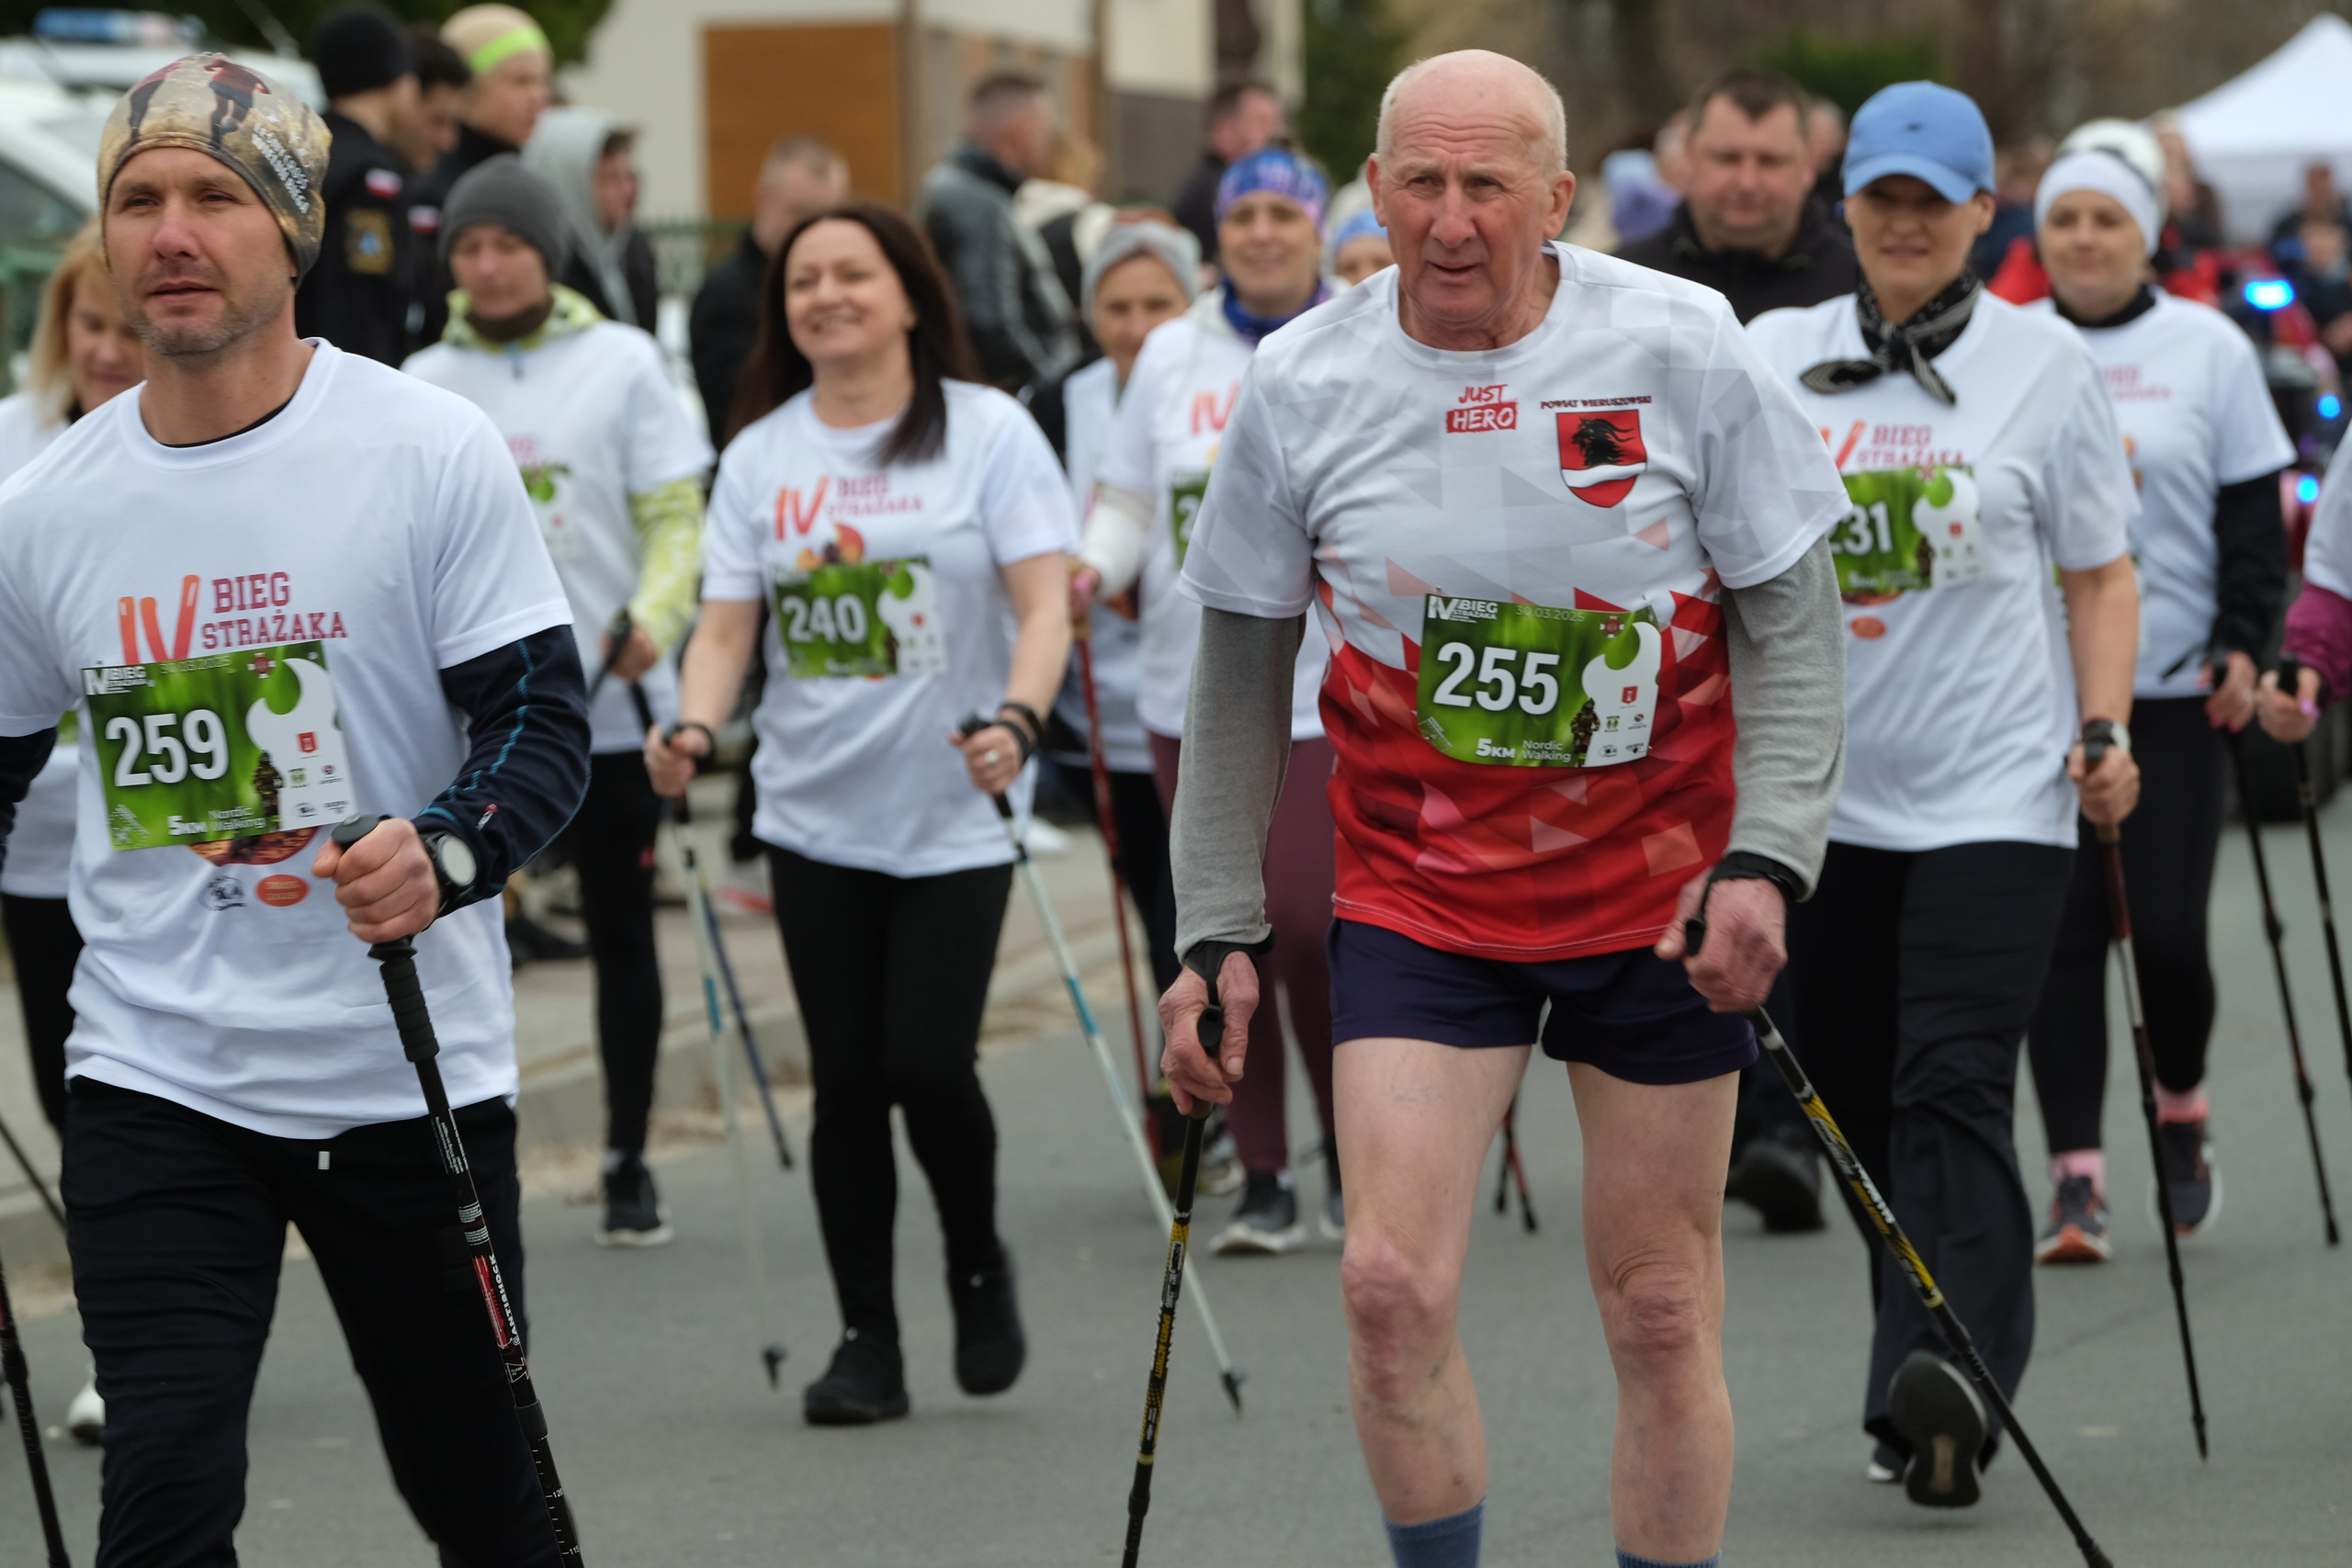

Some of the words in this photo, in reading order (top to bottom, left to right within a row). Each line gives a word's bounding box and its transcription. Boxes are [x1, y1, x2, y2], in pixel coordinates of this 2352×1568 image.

[1458, 384, 1509, 403] JUST
[1541, 400, 1578, 409] POWIAT
[1453, 407, 1515, 430] HERO
[775, 476, 830, 542] IV
[1831, 501, 1893, 555] 31
[1457, 599, 1498, 614] BIEG
[1516, 605, 1586, 623] 30.03.2025
[118, 574, 200, 665] IV
[211, 571, 290, 614] BIEG
[781, 594, 867, 643] 240
[201, 609, 348, 649] STRAŻAKA
[108, 666, 147, 681] BIEG
[1432, 641, 1560, 716] 255
[106, 709, 229, 787] 259
[1476, 738, 1516, 759] 5KM
[1522, 739, 1563, 750] Nordic
[1521, 750, 1571, 763] Walking
[208, 807, 253, 820] Nordic
[211, 817, 266, 832] Walking
[489, 1253, 517, 1337] ANTISHOCK
